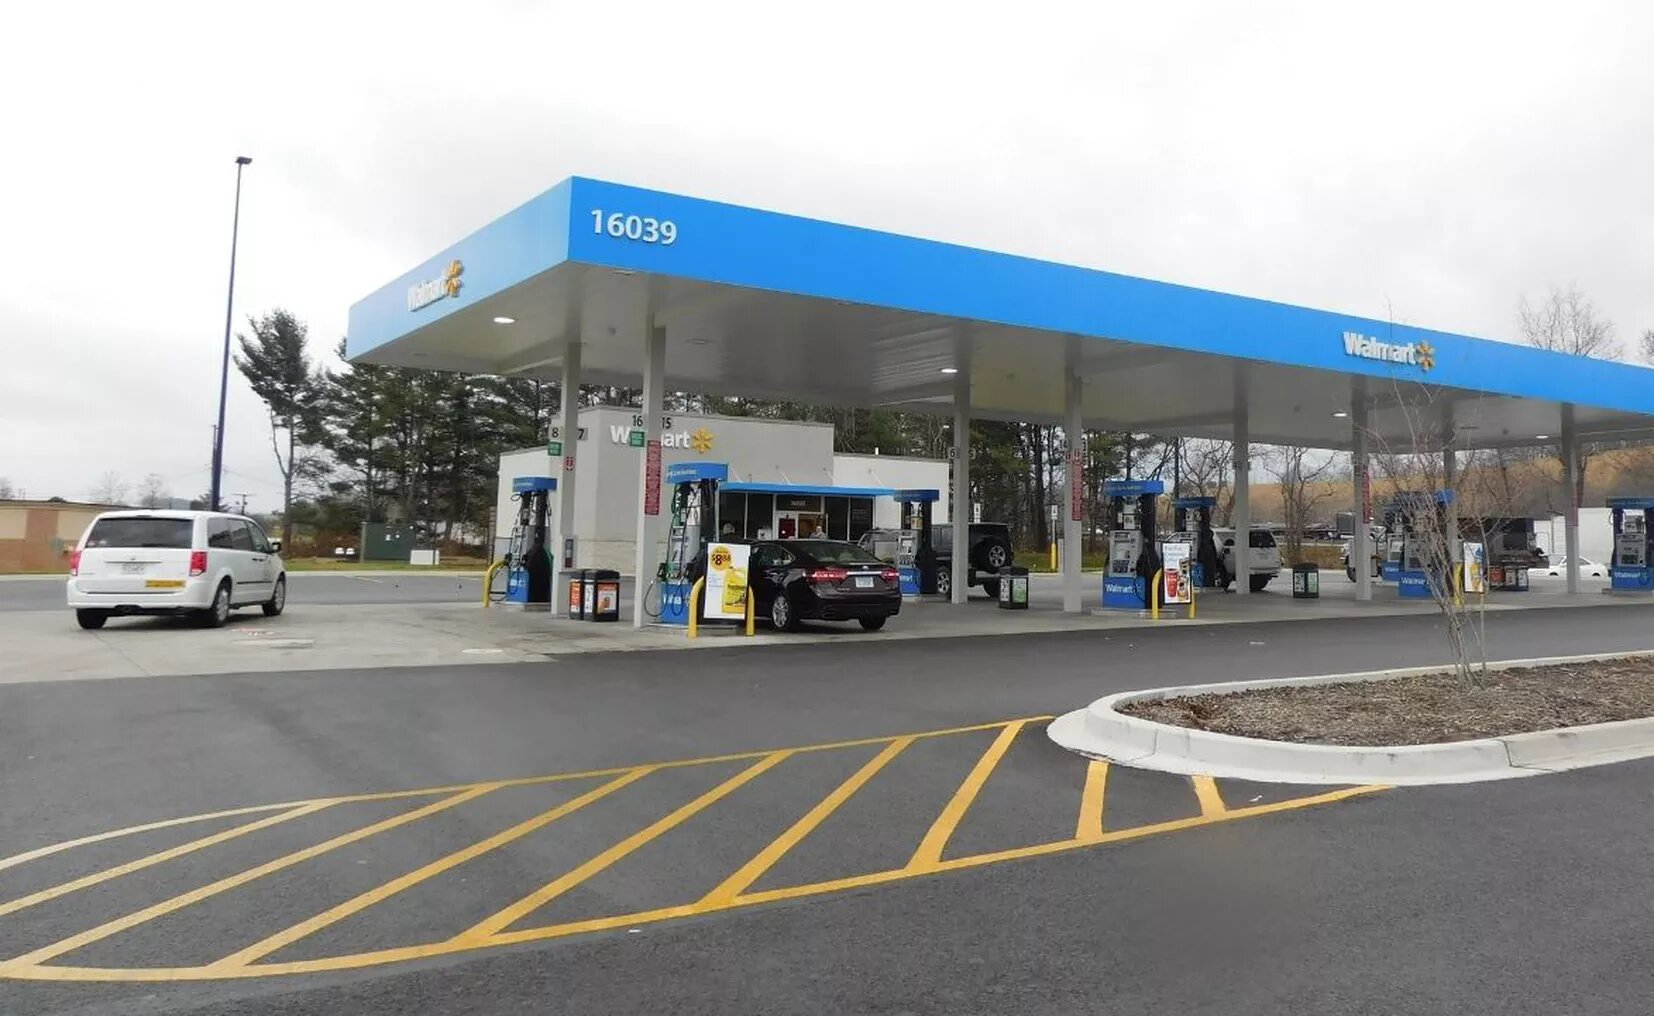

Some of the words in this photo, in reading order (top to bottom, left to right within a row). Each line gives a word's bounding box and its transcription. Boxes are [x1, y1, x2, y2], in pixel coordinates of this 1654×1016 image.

[591, 209, 677, 245] 16039
[1343, 331, 1416, 365] Walmart
[632, 415, 643, 427] 16
[662, 417, 672, 429] 15
[552, 428, 559, 438] 8
[577, 429, 585, 439] 7
[610, 425, 690, 449] Wart
